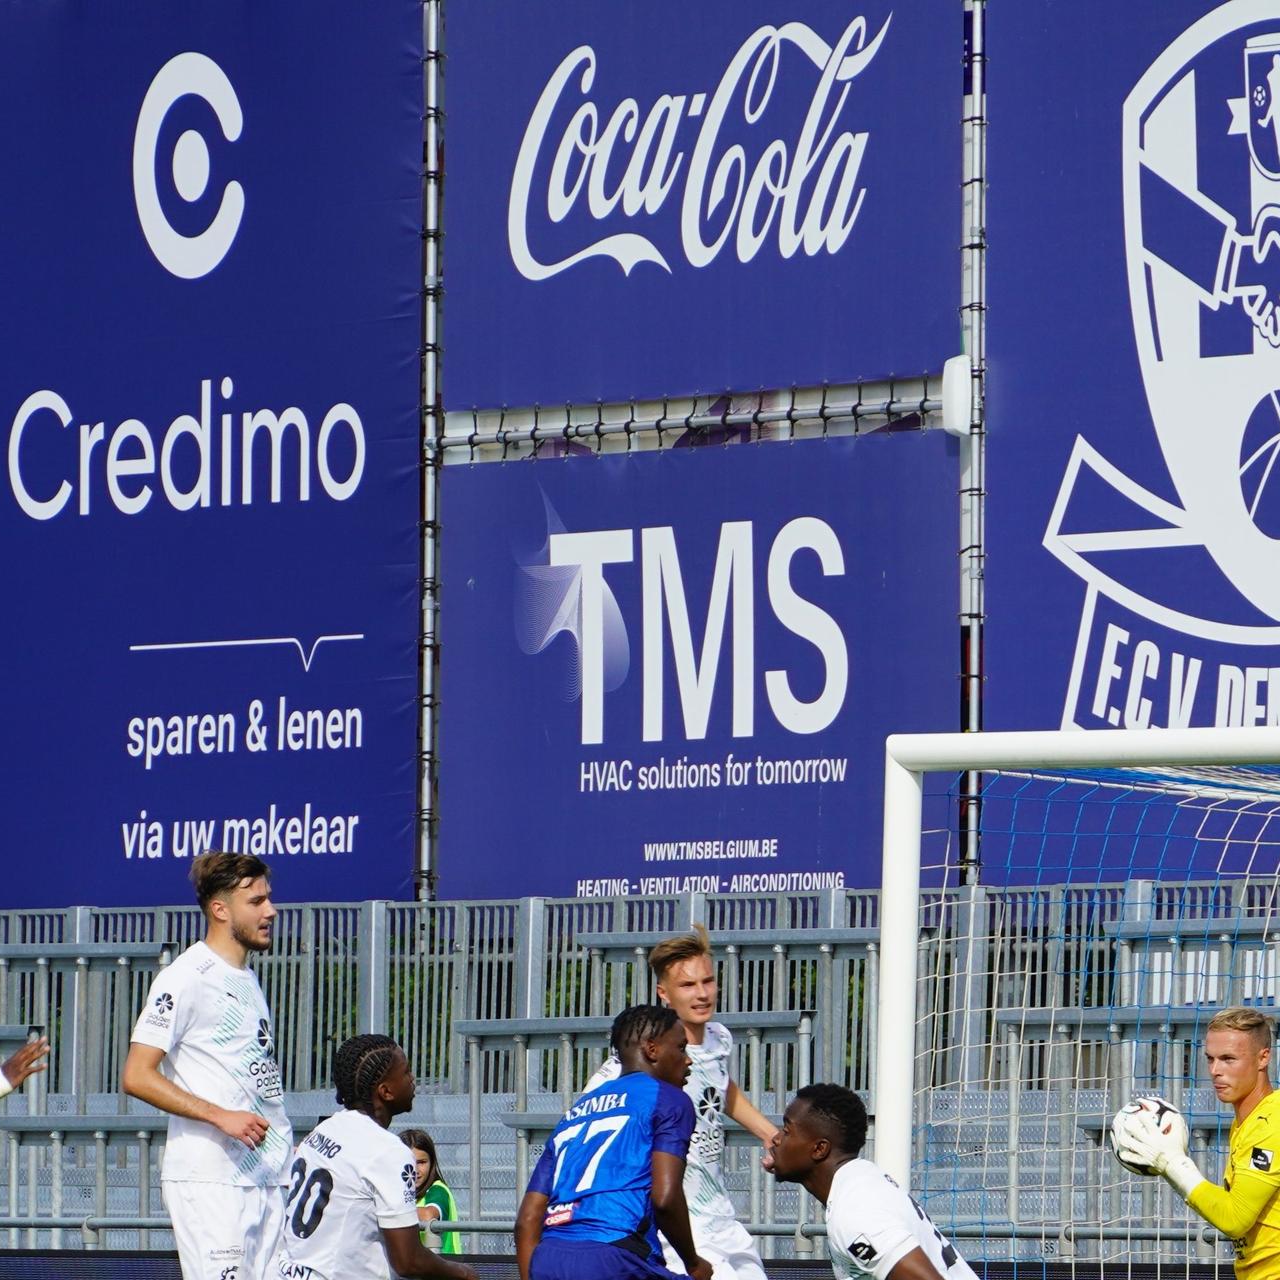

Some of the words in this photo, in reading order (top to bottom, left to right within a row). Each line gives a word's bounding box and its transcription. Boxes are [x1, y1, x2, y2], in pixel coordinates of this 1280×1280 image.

[508, 11, 893, 282] Coca-Cola
[8, 377, 367, 520] Credimo
[548, 515, 850, 747] TMS
[127, 711, 236, 770] sparen
[245, 702, 268, 750] &
[278, 697, 363, 751] lenen
[580, 760, 632, 792] HVAC
[638, 757, 720, 790] solutions
[725, 754, 752, 786] for
[756, 756, 847, 785] tomorrow
[122, 810, 163, 859] via
[172, 820, 215, 857] uw
[223, 803, 359, 855] makelaar
[644, 839, 778, 861] WWW.TMSBELGIUM.BE
[577, 878, 629, 898] HEATING
[640, 874, 719, 896] VENTILATION
[730, 872, 844, 893] AIRCONDITIONING
[553, 1115, 630, 1192] 77
[285, 1157, 333, 1239] 20
